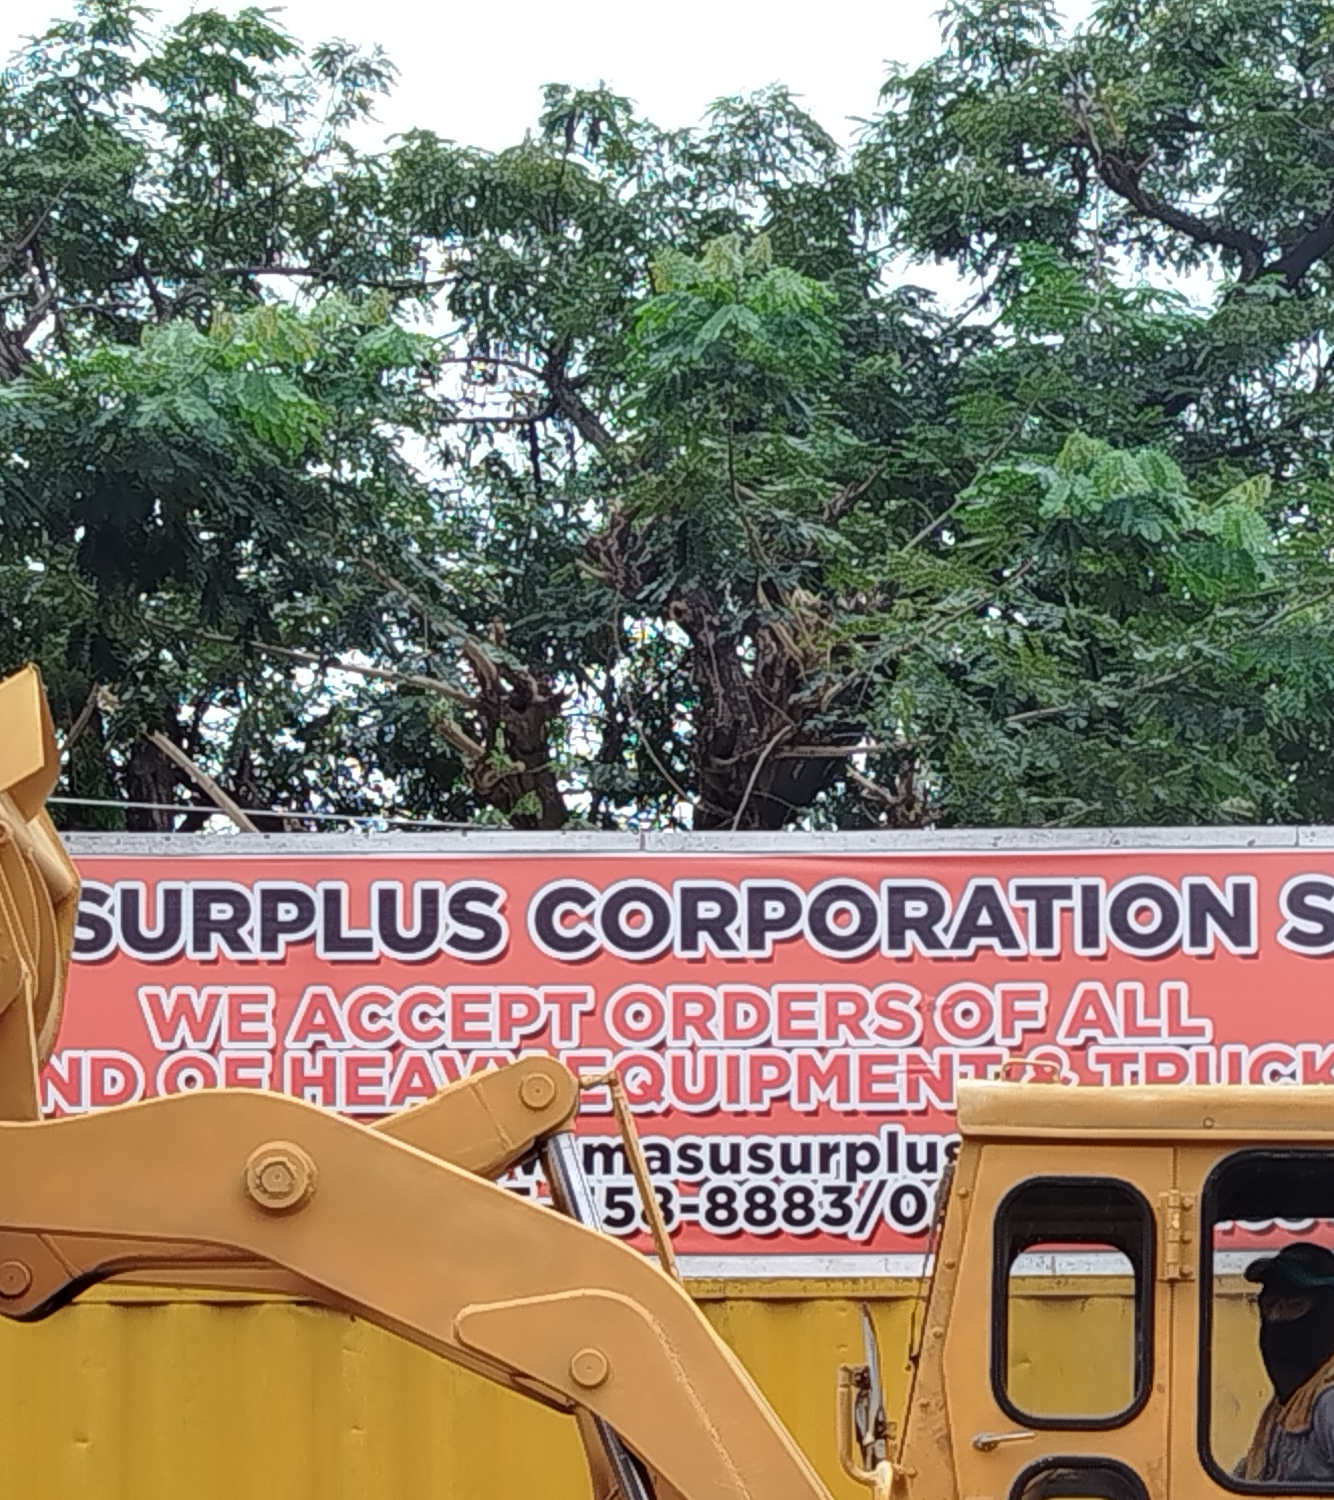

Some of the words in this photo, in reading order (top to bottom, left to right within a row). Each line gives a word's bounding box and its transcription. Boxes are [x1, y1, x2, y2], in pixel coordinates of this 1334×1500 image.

[70, 879, 511, 961] SURPLUS
[528, 875, 1256, 961] CORPORATION
[138, 985, 275, 1050] WE
[285, 984, 594, 1050] ACCEPT
[607, 983, 923, 1048] ORDERS
[934, 982, 1048, 1046] OF
[1062, 981, 1213, 1046] ALL
[40, 1049, 145, 1112] ND
[157, 1049, 273, 1097] OF
[283, 1049, 527, 1113] HEA
